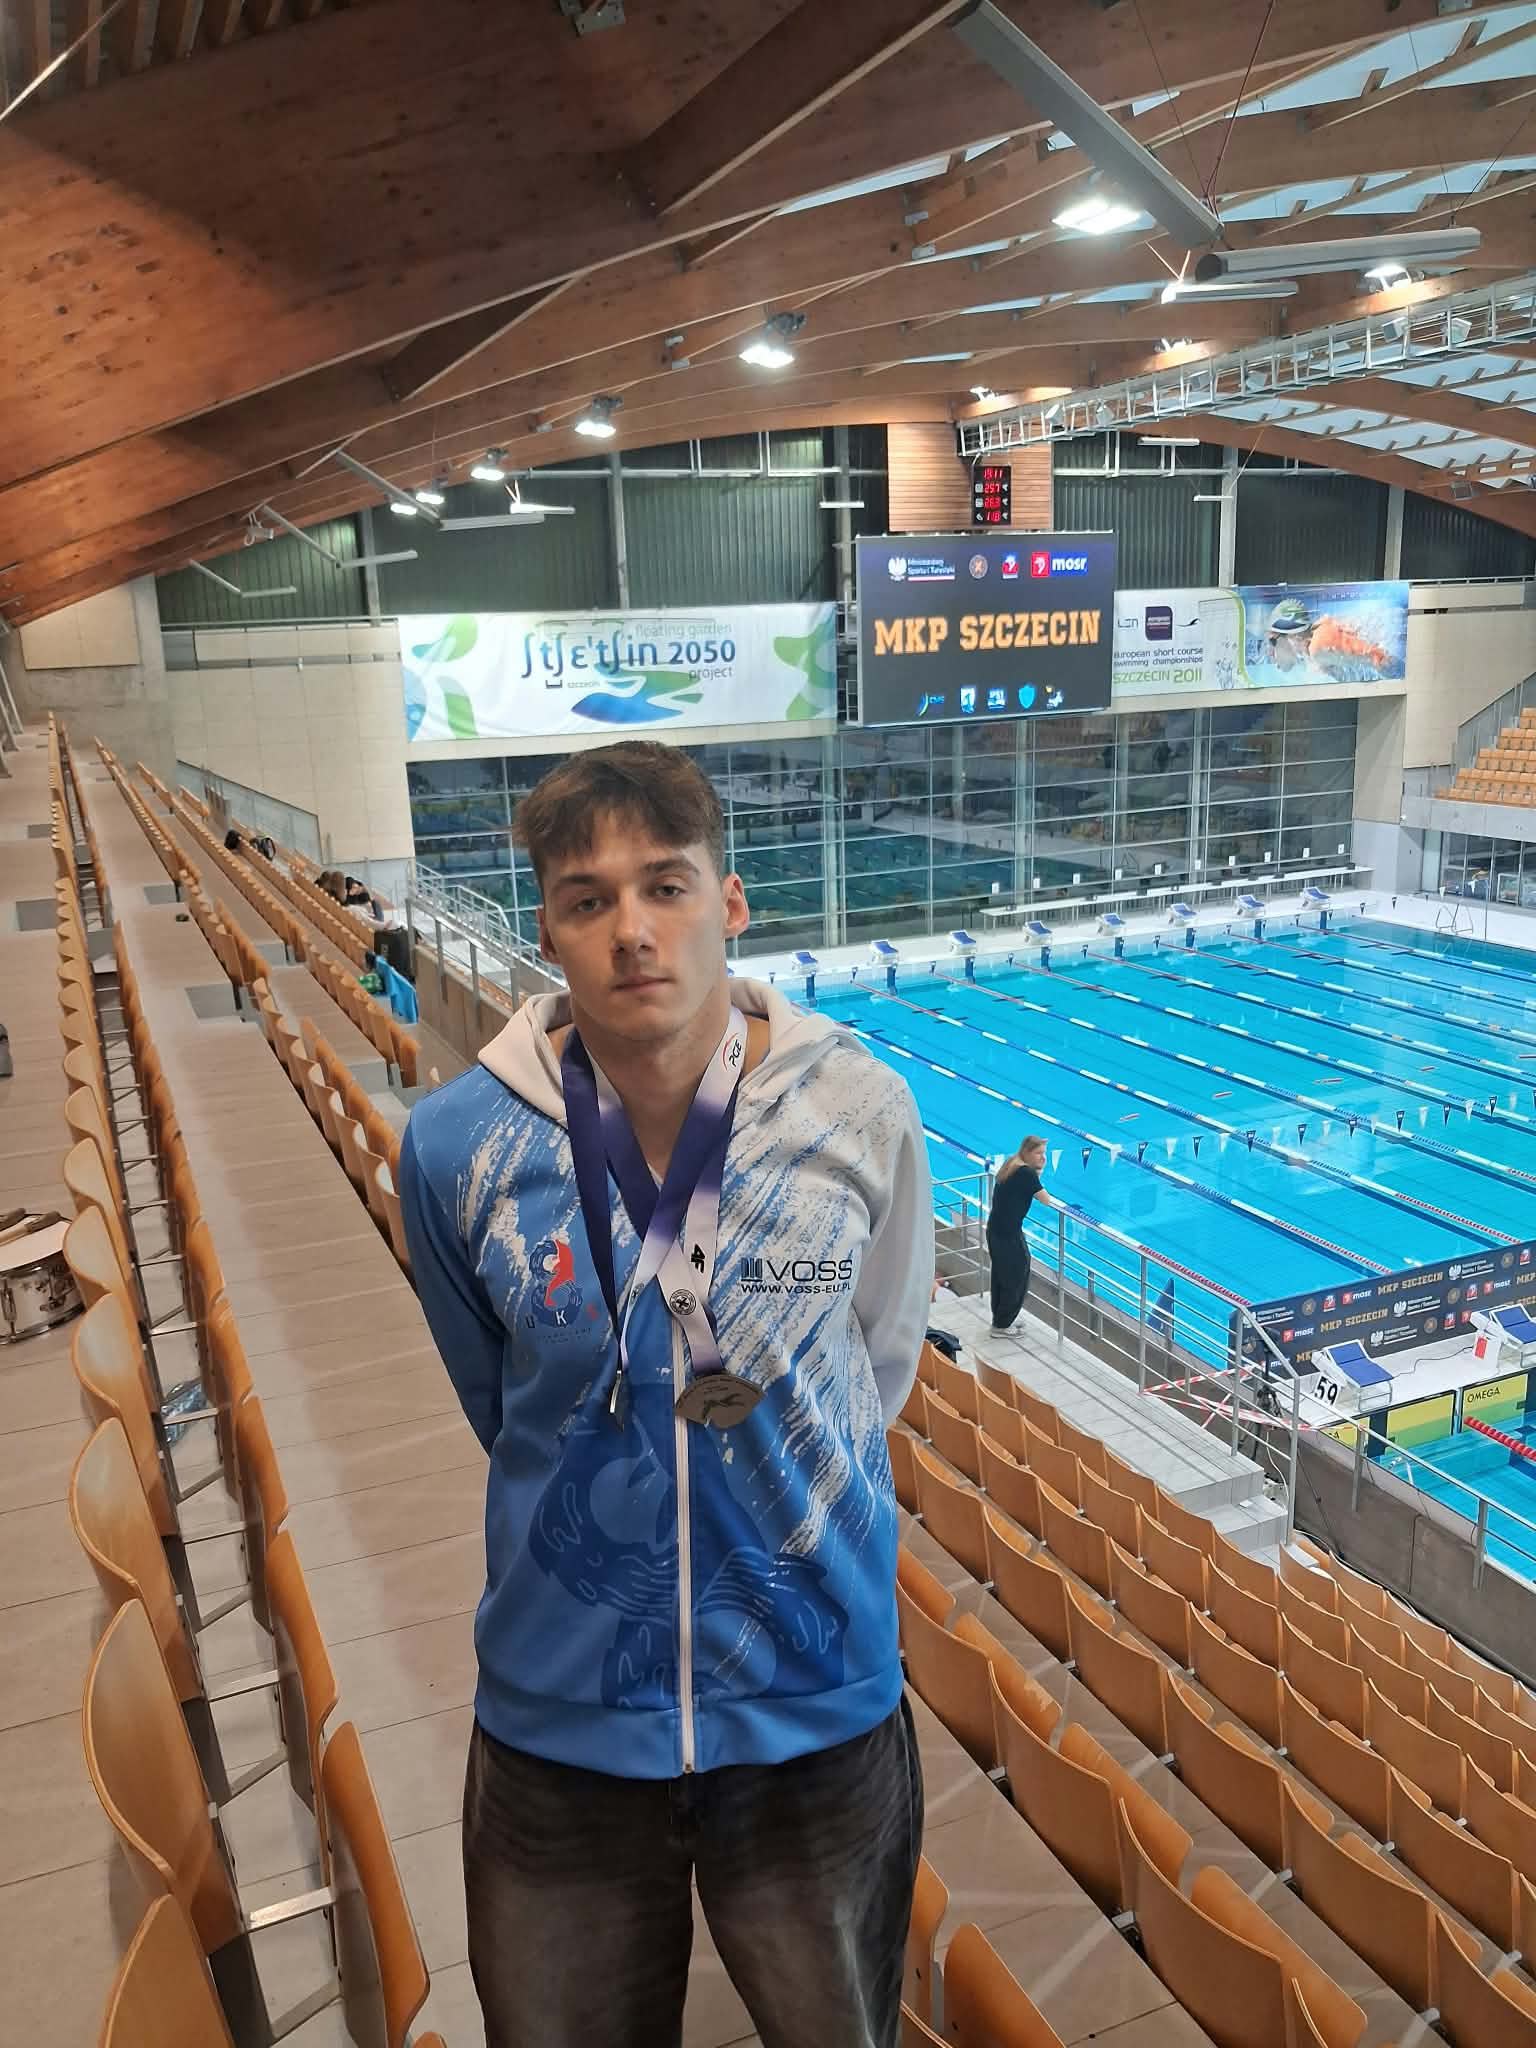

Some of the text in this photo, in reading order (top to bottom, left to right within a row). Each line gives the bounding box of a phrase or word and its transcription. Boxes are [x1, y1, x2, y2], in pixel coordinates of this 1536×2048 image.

[1052, 557, 1087, 571] mosr
[874, 609, 1101, 655] MKP SZCZECIN
[668, 639, 736, 665] 2050
[1153, 648, 1174, 656] short
[688, 666, 733, 681] project
[1112, 667, 1202, 684] SZCZECIN 2011
[728, 1039, 742, 1068] PGE
[766, 1259, 853, 1282] VOSS
[556, 1310, 568, 1326] K
[1314, 1375, 1338, 1405] 59
[1467, 1387, 1500, 1403] OMEGA
